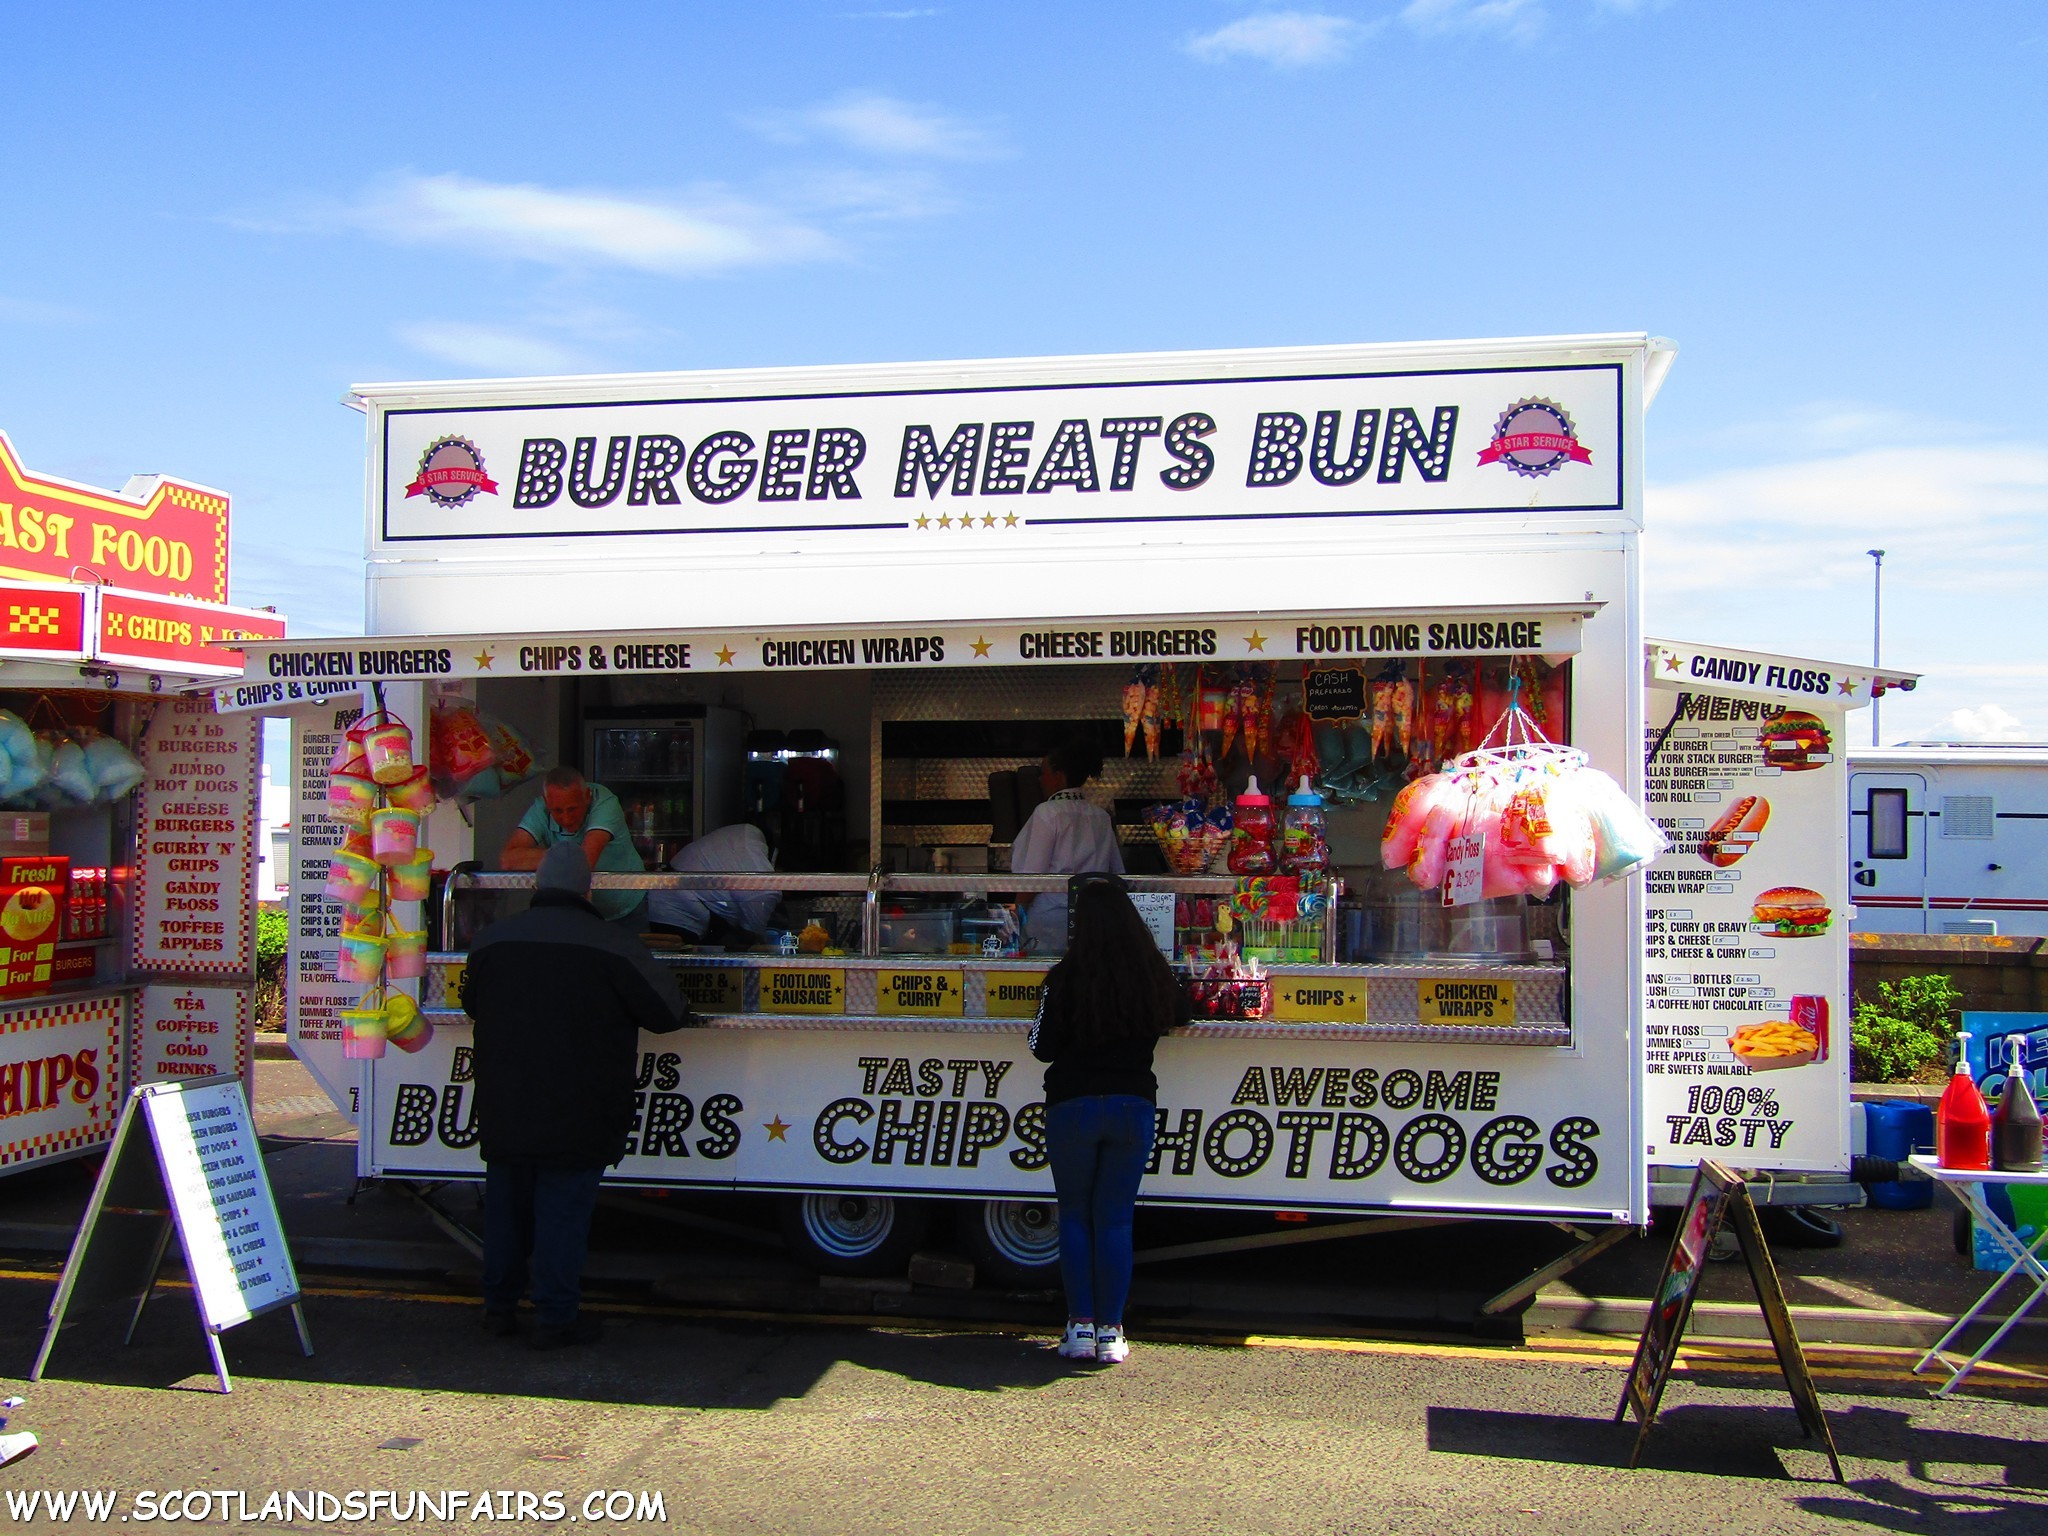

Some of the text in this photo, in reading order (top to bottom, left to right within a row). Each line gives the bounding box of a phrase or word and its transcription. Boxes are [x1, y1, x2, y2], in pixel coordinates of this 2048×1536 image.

[1494, 436, 1574, 452] 5 STAR SERVICE
[513, 406, 1459, 509] BURGER MEATS BUN
[419, 470, 485, 486] 5 STAR SERVICE
[0, 503, 193, 582] AST FOOD
[127, 615, 192, 645] CHIPS
[1296, 621, 1542, 653] FOOTLONG SAUSAGE
[1019, 628, 1218, 659] CHEESE BURGERS
[520, 644, 691, 671] CHIPS & CHEESE
[762, 636, 945, 667] CHICKEN WRAPS
[268, 649, 452, 677] CHICKEN BURGERS
[1315, 673, 1349, 687] CASH
[1691, 655, 1831, 695] CANDY FLOSS
[236, 681, 302, 707] CHIPS &
[1676, 692, 1787, 722] MENU
[173, 725, 198, 737] 1/4
[303, 734, 331, 744] BURGER
[1673, 741, 1708, 751] BURGER
[158, 741, 238, 753] BURGERS
[303, 746, 329, 755] DOUBLE
[302, 757, 319, 767] NEW
[1661, 754, 1685, 764] YORK
[1687, 754, 1716, 764] STACK
[1718, 754, 1753, 764] BURGER
[169, 764, 226, 776] JUMBO
[1673, 766, 1708, 777] BURGER
[153, 780, 239, 792] HOT DOGS
[302, 780, 327, 789] BACON
[1670, 780, 1705, 790] BURGER
[302, 791, 326, 800] BACON
[1670, 792, 1692, 803] ROLL
[162, 803, 229, 815] CHEESE
[155, 819, 235, 832] BURGERS
[302, 814, 316, 823] HOT
[1658, 818, 1676, 829] DOG
[302, 825, 338, 835] FOOTLONG
[1685, 831, 1727, 842] SAUSAGE
[152, 842, 210, 855] CURRY
[301, 837, 332, 846] GERMAN
[1446, 838, 1480, 865] Candy Floss
[168, 859, 220, 872] CHIPS
[11, 864, 57, 884] Fresh
[1677, 870, 1713, 881] BURGER
[165, 881, 221, 895] CANDY
[1677, 883, 1705, 894] WRAP
[166, 898, 220, 912] FLOSS
[301, 894, 324, 903] CHIPS
[1139, 906, 1171, 914] ONUTS
[1645, 909, 1665, 920] HIPS
[160, 921, 225, 934] TOFFEE
[300, 916, 322, 926] CHIPS
[1670, 922, 1747, 933] CURRY OR GRAVY
[160, 937, 224, 951] APPLES
[1645, 935, 1711, 946] HIPS & CHEESE
[12, 949, 34, 963] For
[300, 950, 320, 960] CANS
[1670, 948, 1747, 959] CHEESE & CURRY
[55, 956, 93, 971] BURGERS
[300, 962, 323, 971] SLUSH
[10, 971, 32, 984] For
[717, 973, 729, 988] &
[773, 974, 832, 989] FOOTLONG
[892, 974, 949, 992] CHIPS &
[1645, 974, 1732, 985] ANS BOTTLES
[772, 990, 833, 1005] SAUSAGE
[1295, 989, 1345, 1007] CHIPS
[1434, 983, 1498, 1001] CHICKEN
[1697, 986, 1726, 998] TWIST
[1728, 987, 1747, 998] CUP
[173, 998, 206, 1011] TEA
[299, 996, 348, 1006] CANDY FLOSS
[898, 991, 943, 1008] CURRY
[1712, 1000, 1764, 1011] CHOCOLATE
[299, 1007, 333, 1017] DUMMIES
[1438, 1001, 1494, 1018] WRAPS
[156, 1019, 220, 1034] COFFEE
[299, 1019, 323, 1029] TOFFEE
[1645, 1025, 1700, 1036] ANDY FLOSS
[299, 1030, 319, 1040] MORE
[166, 1043, 209, 1057] COLD
[1672, 1051, 1707, 1062] APPLES
[157, 1061, 218, 1075] DRINKS
[1667, 1064, 1753, 1076] SWEETS AVAILABLE
[0, 1049, 99, 1120] HIPS
[857, 1057, 1014, 1099] TASTY
[1231, 1066, 1501, 1112] AWESOME
[1687, 1085, 1780, 1118] 100%
[201, 1106, 231, 1120] BURGERS
[208, 1121, 238, 1136] BURGERS
[813, 1097, 1052, 1172] CHIPS
[1665, 1115, 1794, 1149] TASTY
[210, 1140, 231, 1154] DOGS
[1144, 1108, 1601, 1189] HOTDOGS
[219, 1155, 245, 1169] WRAPS
[226, 1169, 257, 1185] SAUSAGE
[226, 1187, 257, 1204] SAUSAGE
[221, 1208, 242, 1223] CHIPS
[238, 1221, 260, 1236] CURRY
[242, 1237, 267, 1253] CHEESE
[235, 1258, 257, 1274] SLUSH
[248, 1272, 272, 1289] DRINKS
